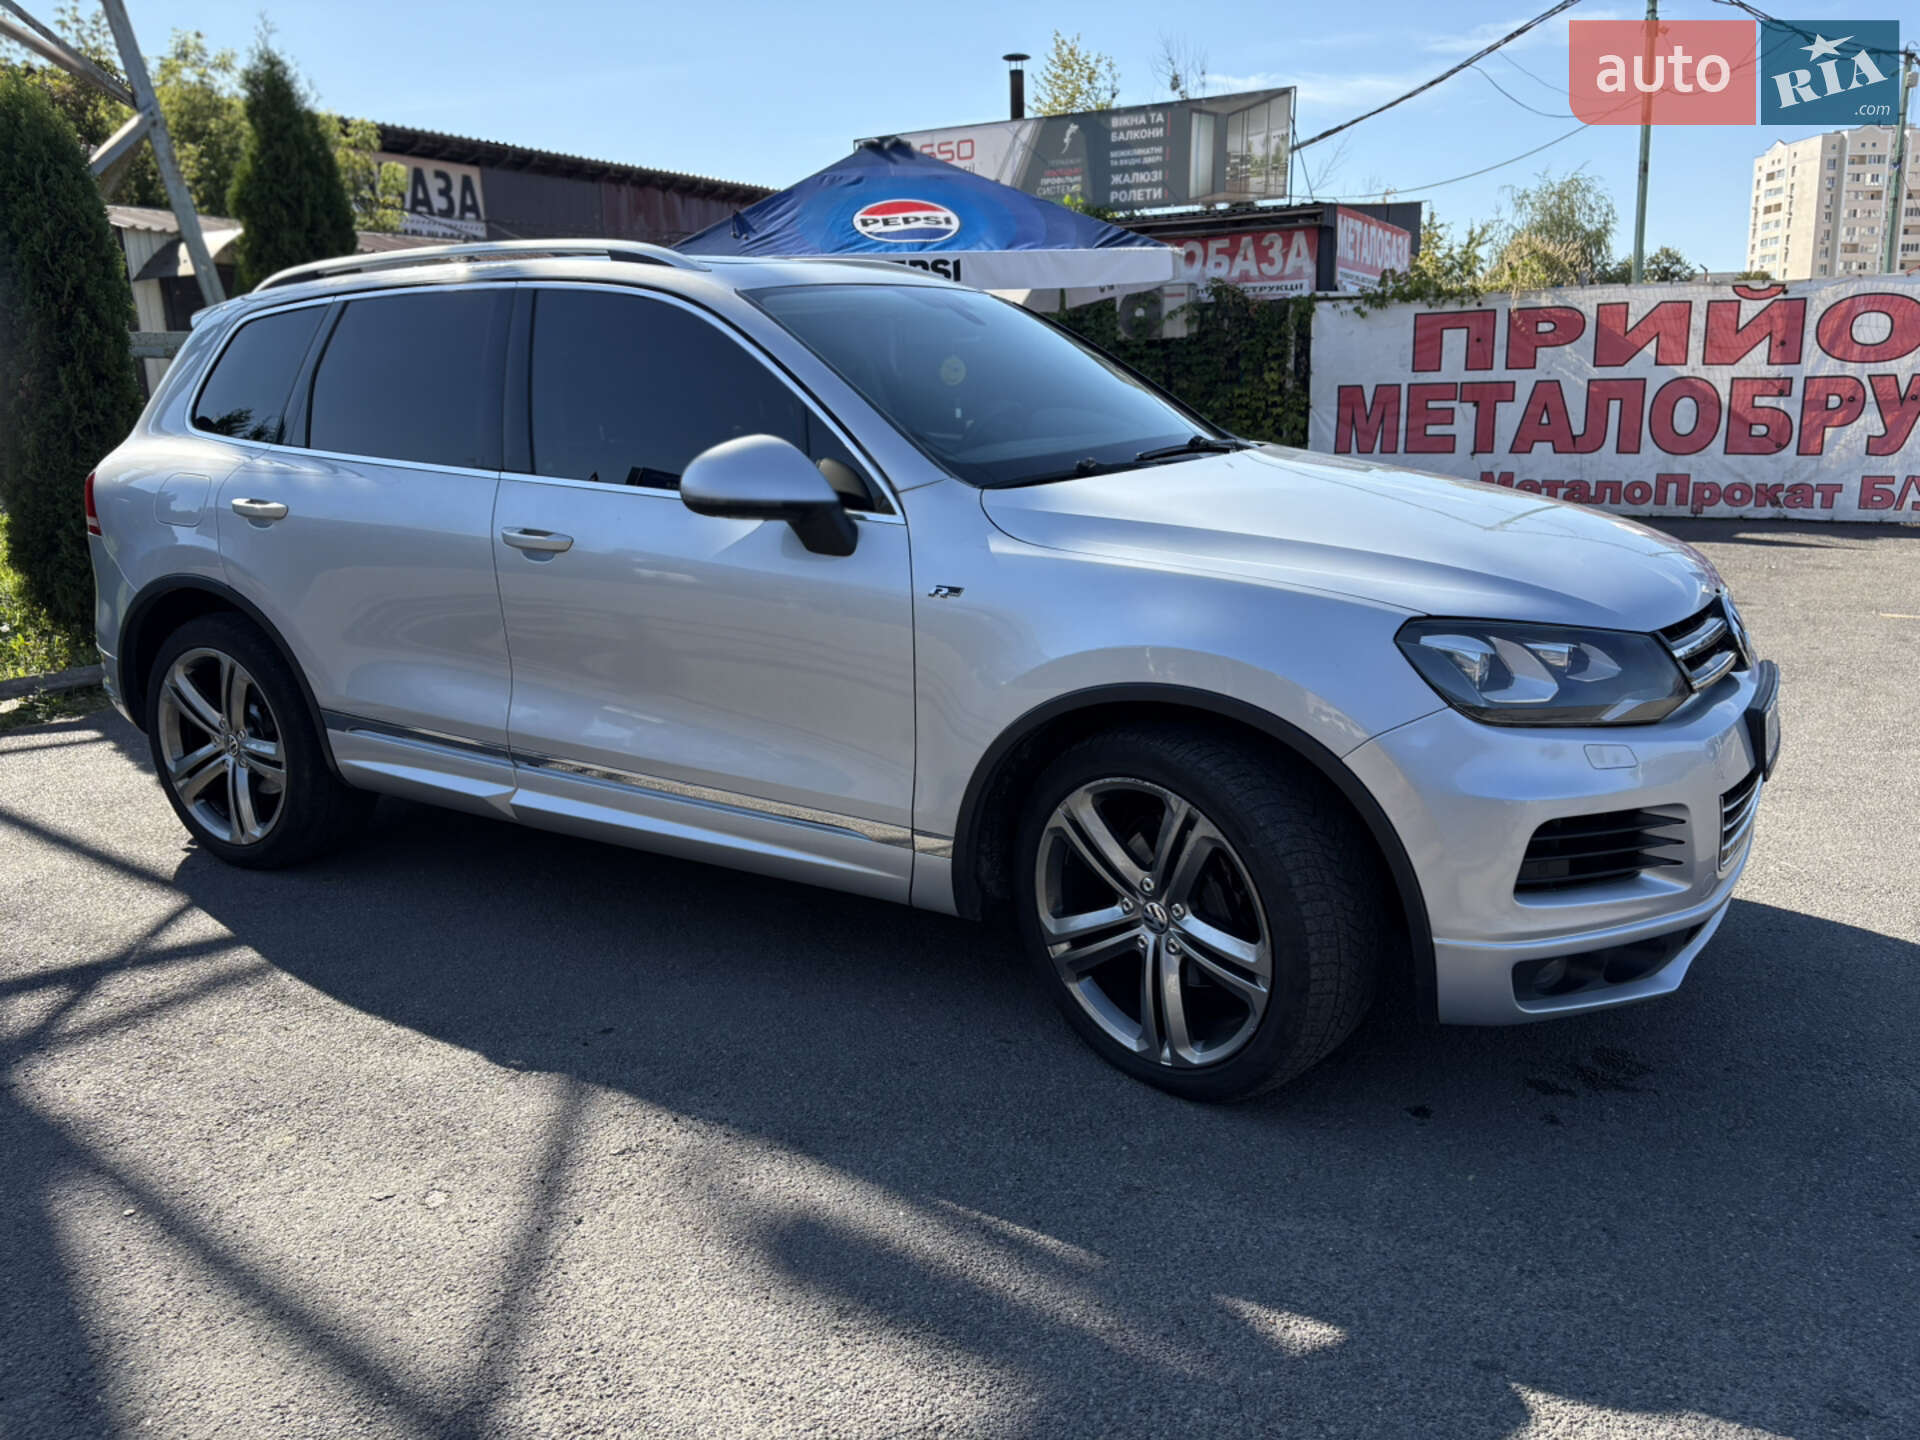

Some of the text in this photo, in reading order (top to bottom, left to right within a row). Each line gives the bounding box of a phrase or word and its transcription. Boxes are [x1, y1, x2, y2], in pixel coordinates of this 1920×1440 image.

[1111, 112, 1164, 128] ВІКНА ТА
[1111, 127, 1164, 142] БАЛКОНИ
[1110, 170, 1162, 185] ЖАЛЮЗІ
[1110, 187, 1163, 203] РОЛЕТИ
[859, 215, 953, 227] PEPSI
[1411, 283, 1920, 372] ПРИЙО
[1334, 374, 1920, 457] МЕТАЛОБРУ
